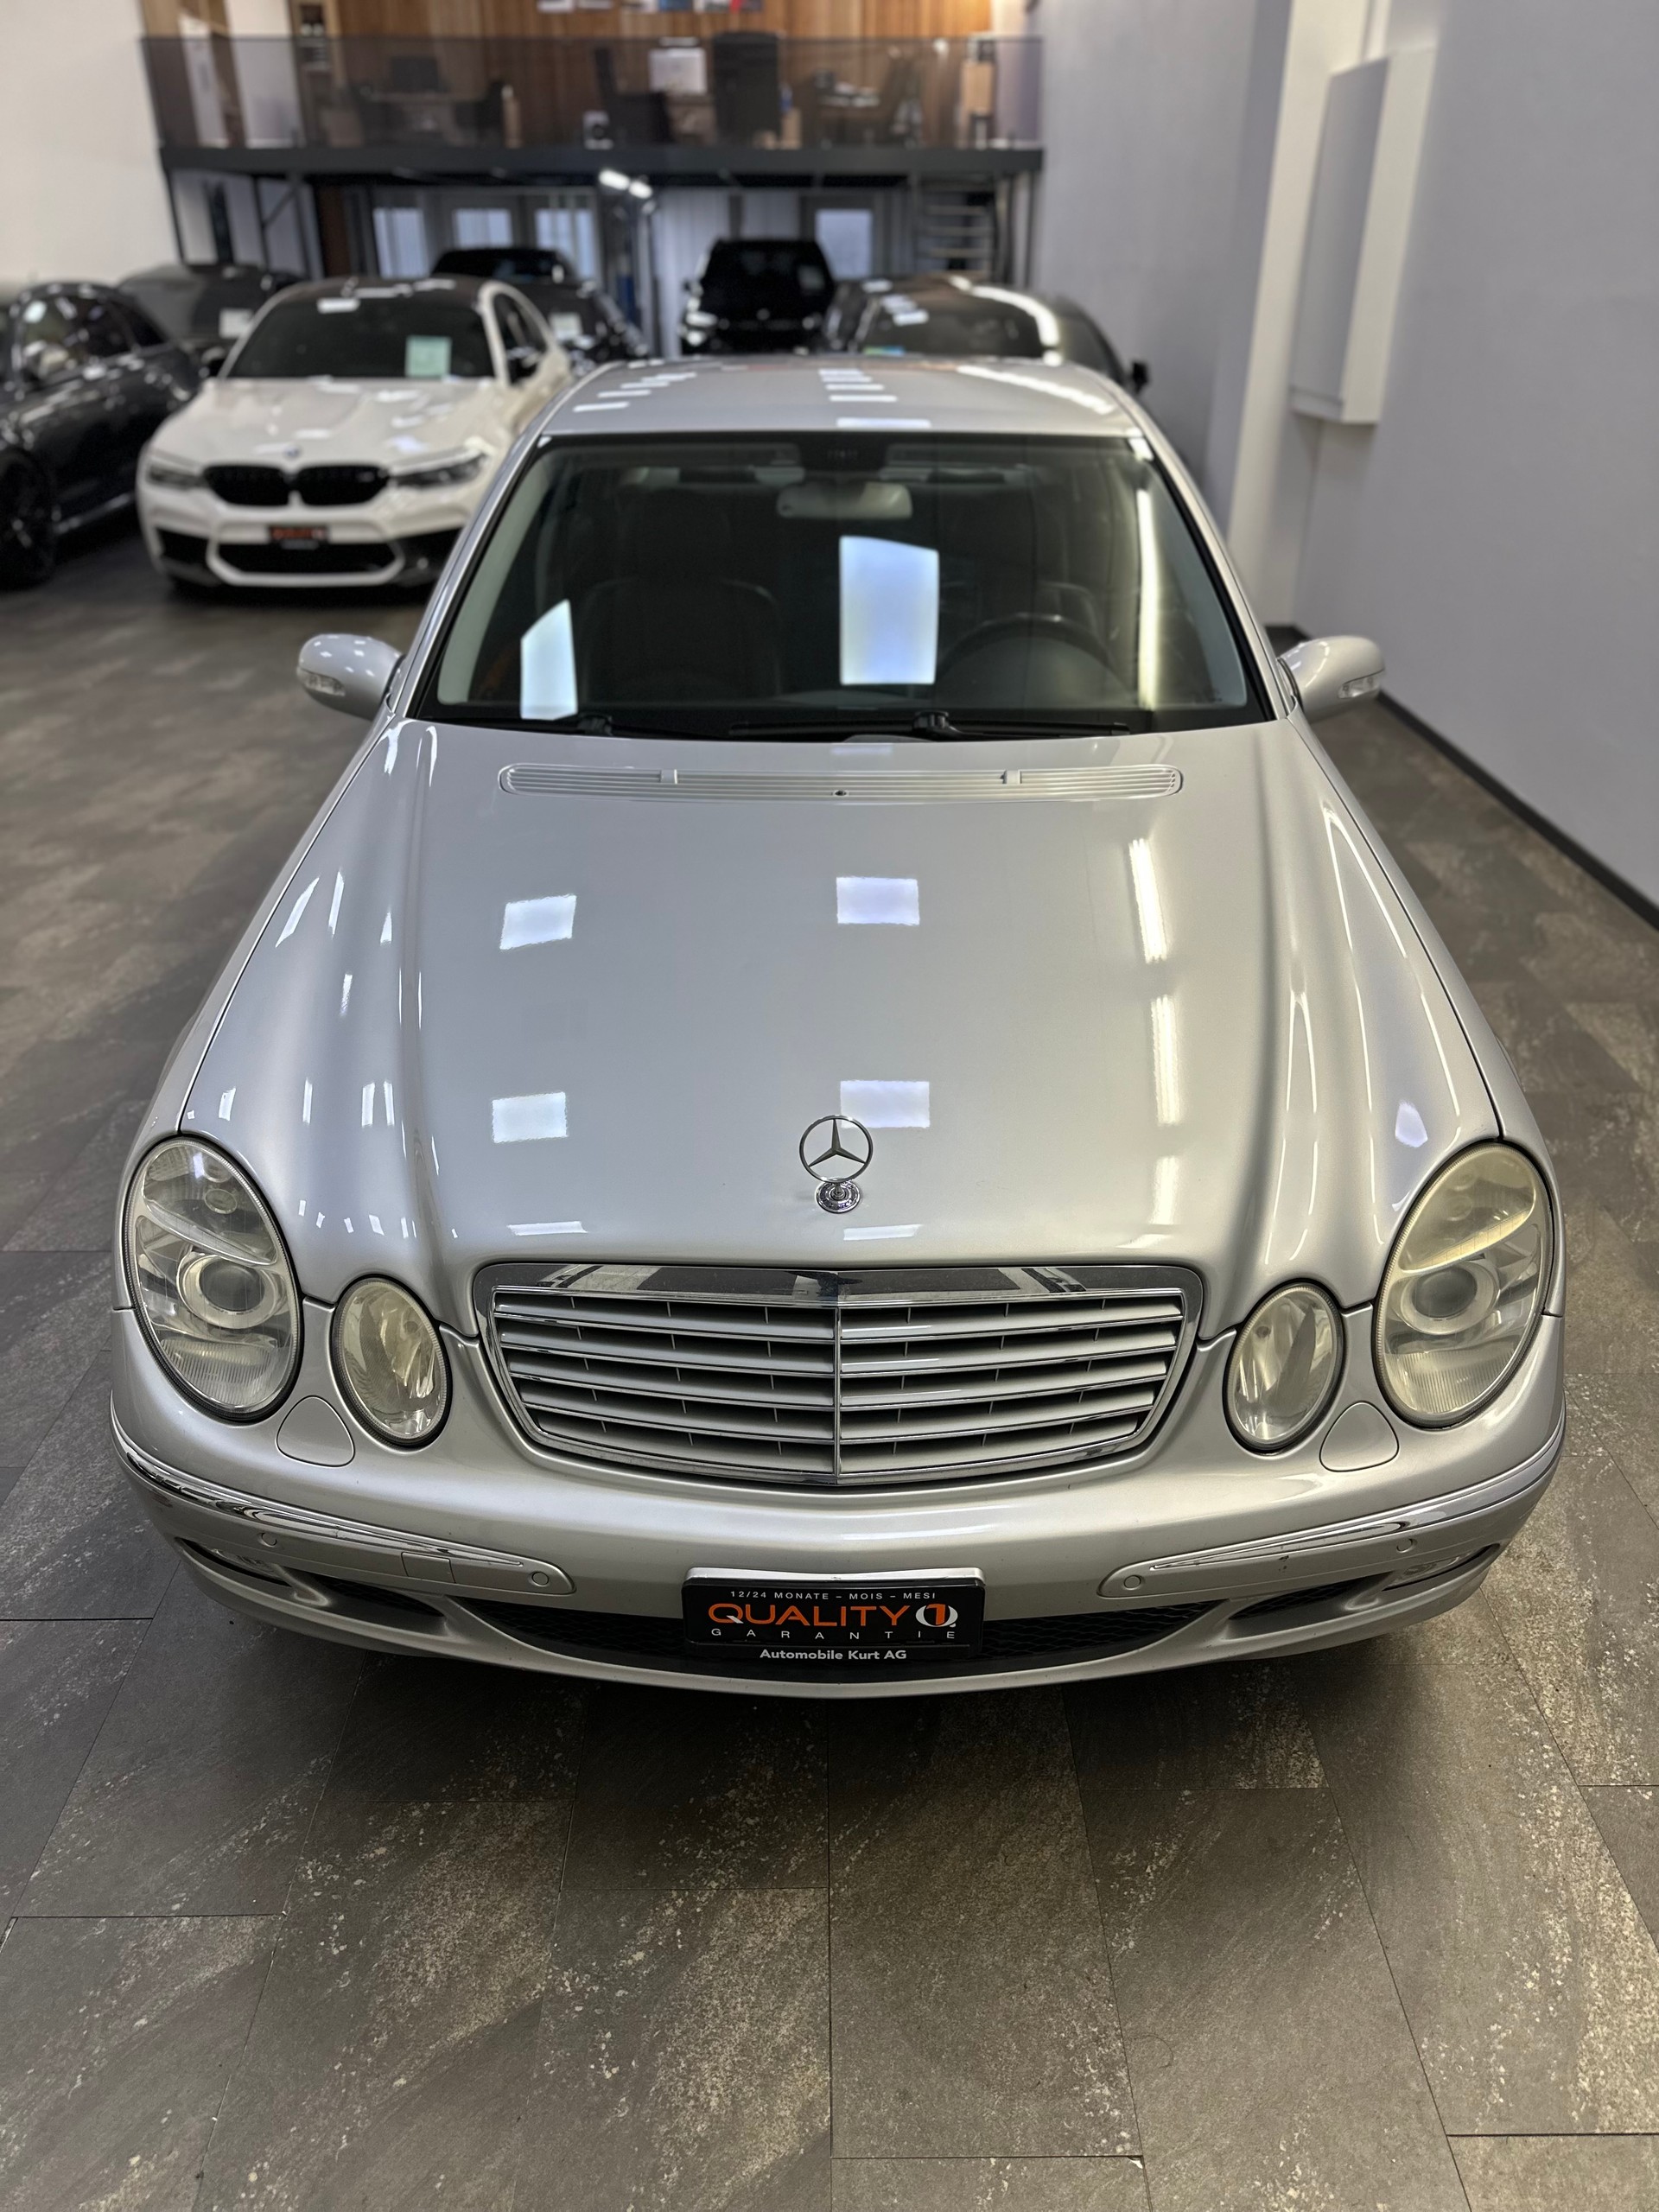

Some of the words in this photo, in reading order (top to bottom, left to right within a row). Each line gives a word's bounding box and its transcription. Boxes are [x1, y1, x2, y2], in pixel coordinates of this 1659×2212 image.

[760, 1649, 843, 1660] Automobile
[848, 1650, 880, 1660] Kurt
[883, 1649, 907, 1660] AG
